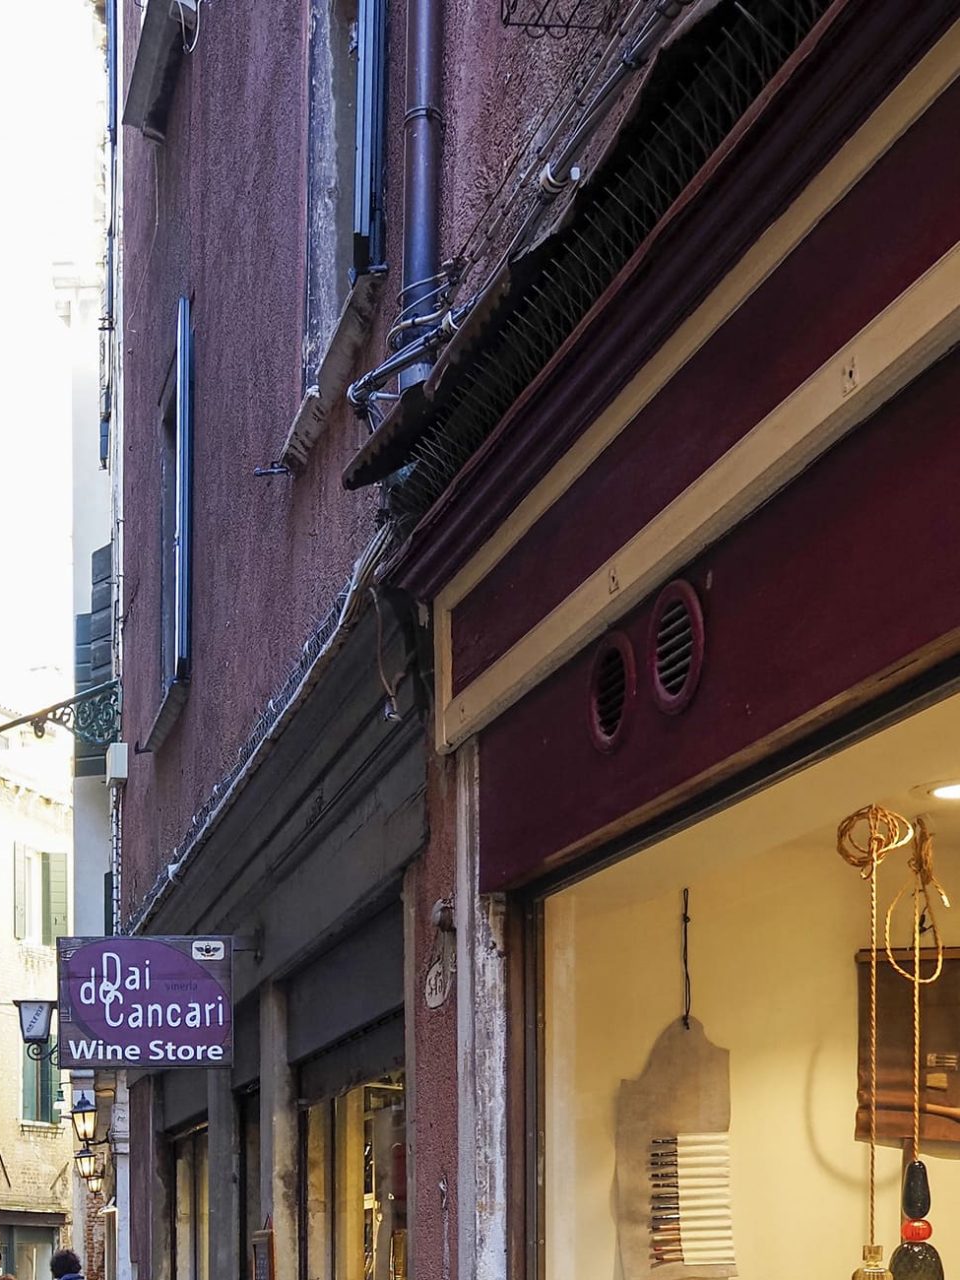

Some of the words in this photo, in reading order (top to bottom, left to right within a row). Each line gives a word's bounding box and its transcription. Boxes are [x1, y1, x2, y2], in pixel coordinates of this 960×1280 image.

[80, 967, 115, 1004] do
[102, 952, 150, 990] Dai
[105, 990, 224, 1028] Cancari
[68, 1040, 140, 1061] Wine
[149, 1040, 224, 1061] Store
